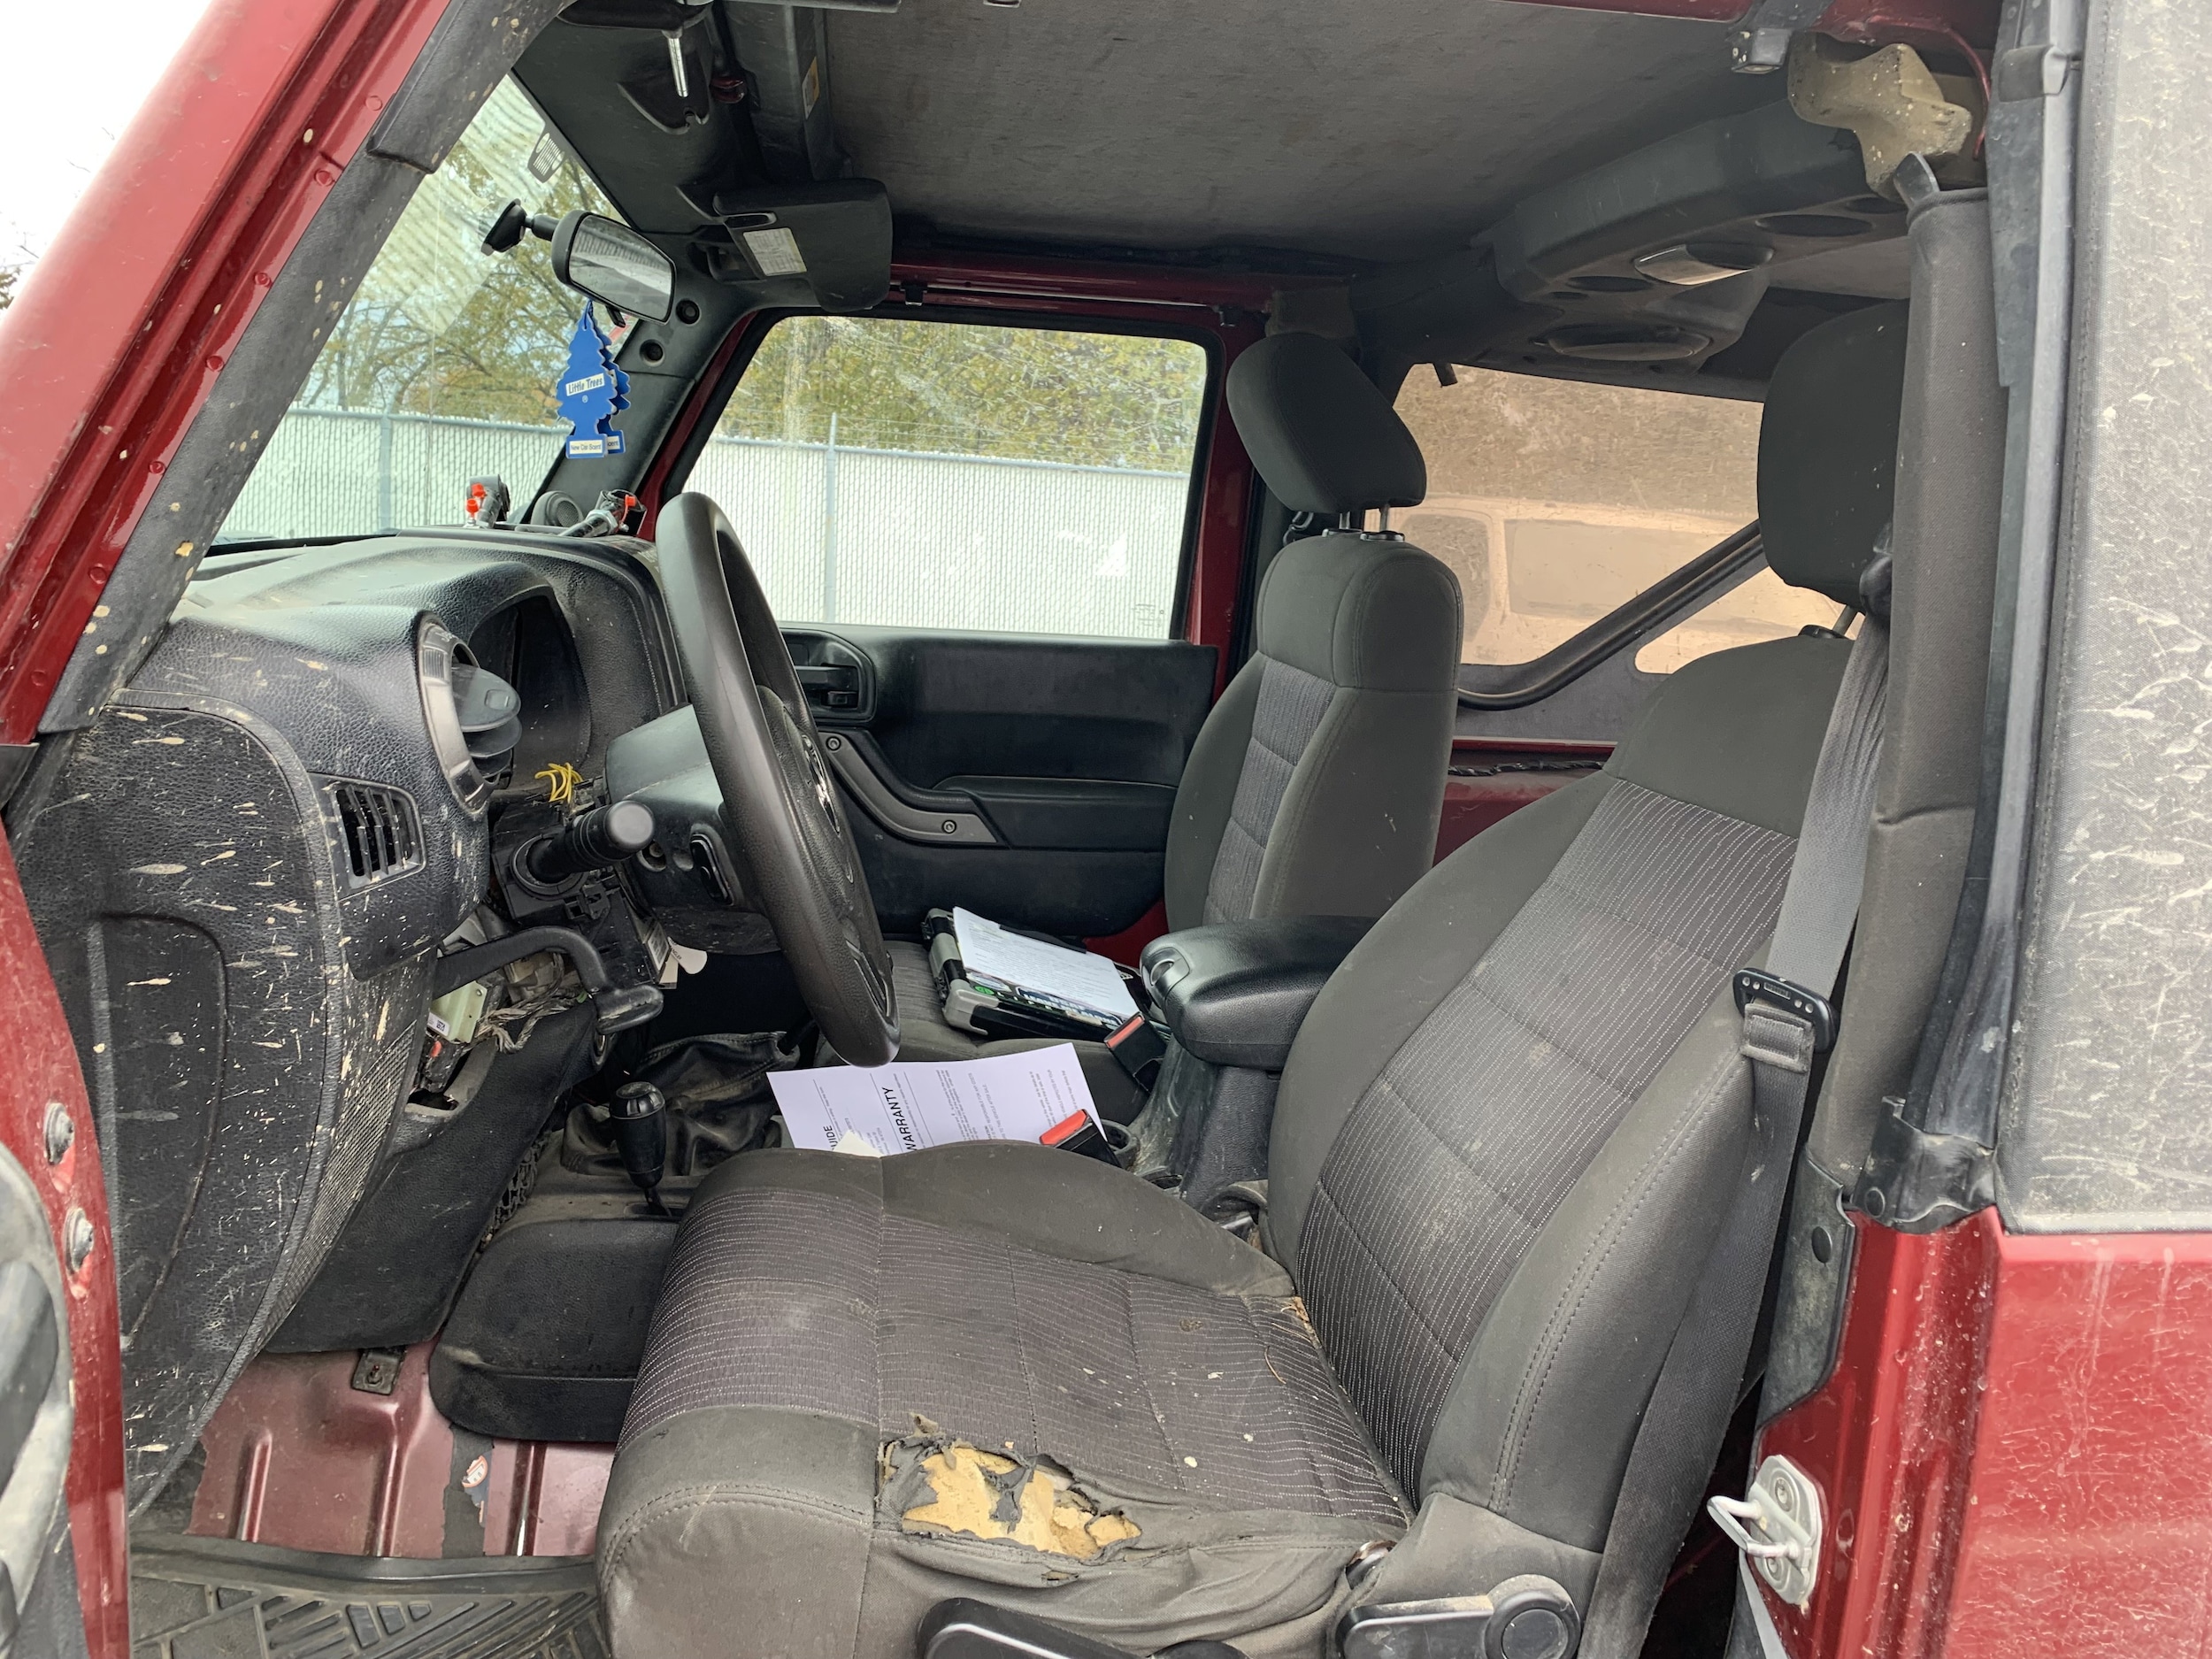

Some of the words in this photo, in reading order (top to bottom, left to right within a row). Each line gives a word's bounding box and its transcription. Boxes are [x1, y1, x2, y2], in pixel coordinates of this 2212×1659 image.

[568, 381, 584, 395] Little
[586, 378, 603, 390] Trees
[881, 1086, 918, 1151] WARRANTY
[823, 1125, 839, 1149] UIDE
